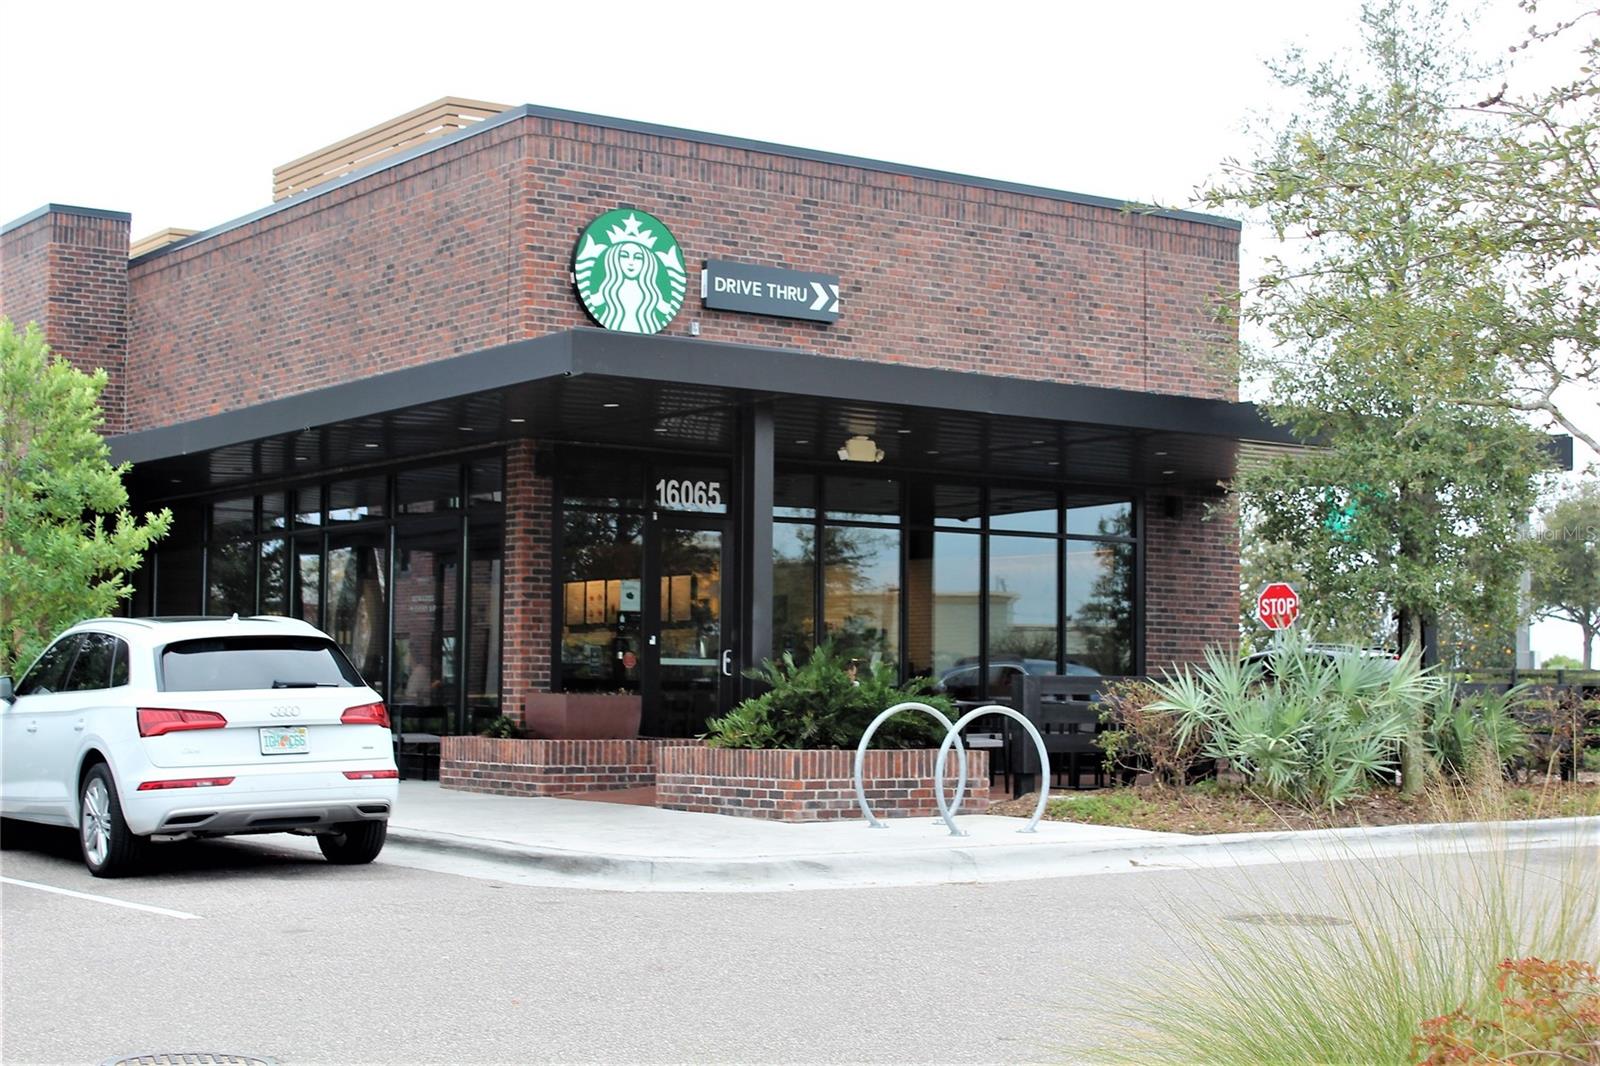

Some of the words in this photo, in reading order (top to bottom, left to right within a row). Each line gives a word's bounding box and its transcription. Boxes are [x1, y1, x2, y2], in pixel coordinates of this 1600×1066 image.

[714, 276, 762, 297] DRIVE
[766, 283, 808, 302] THRU
[655, 479, 721, 509] 16065
[1261, 597, 1296, 616] STOP
